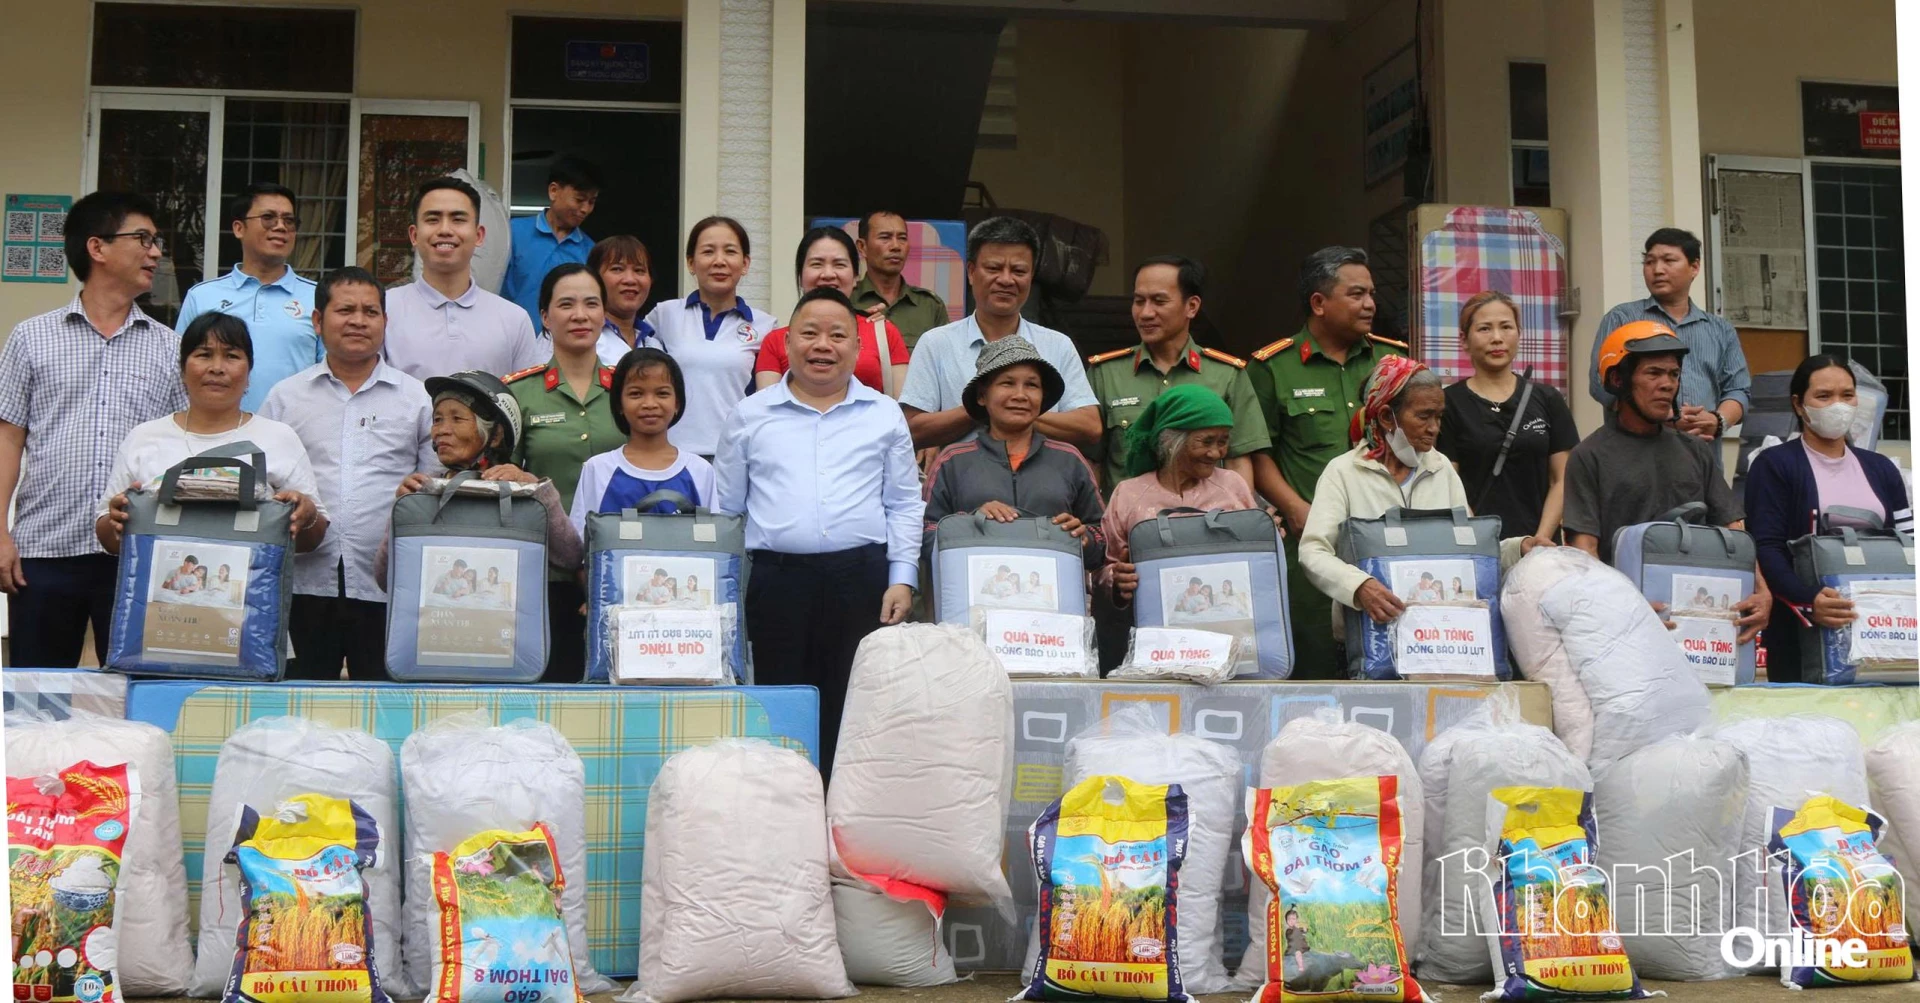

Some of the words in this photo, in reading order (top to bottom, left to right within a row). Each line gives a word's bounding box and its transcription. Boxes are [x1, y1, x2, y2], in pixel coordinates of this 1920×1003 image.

[1867, 615, 1893, 628] QUÀ
[1003, 630, 1030, 643] QUÀ
[1033, 630, 1065, 648] TẶNG
[1413, 627, 1440, 642] QUÀ
[1443, 627, 1474, 644] TẶNG
[1150, 648, 1175, 662] QUÀ
[1683, 637, 1707, 652] QUÀ
[1710, 638, 1733, 656] TẶNG
[1130, 849, 1163, 864] CÂU
[1309, 841, 1341, 859] GẠO
[1284, 855, 1311, 875] ĐÀI
[1313, 855, 1360, 872] THƠM
[1363, 855, 1372, 865] 8
[1540, 960, 1559, 979] BỒ
[1562, 962, 1587, 977] CÂU
[1590, 961, 1624, 976] THƠM
[1877, 954, 1906, 968] THƠM
[474, 969, 485, 982] 8
[489, 969, 541, 984] THƠM
[545, 969, 569, 986] ĐÀI
[1057, 963, 1077, 981] BỒ
[1080, 967, 1109, 982] CÂU
[1113, 970, 1154, 984] THƠM
[253, 975, 275, 994] BỒ
[279, 977, 309, 993] CÂU
[315, 977, 358, 992] THƠM
[504, 986, 542, 1003] GẠO
